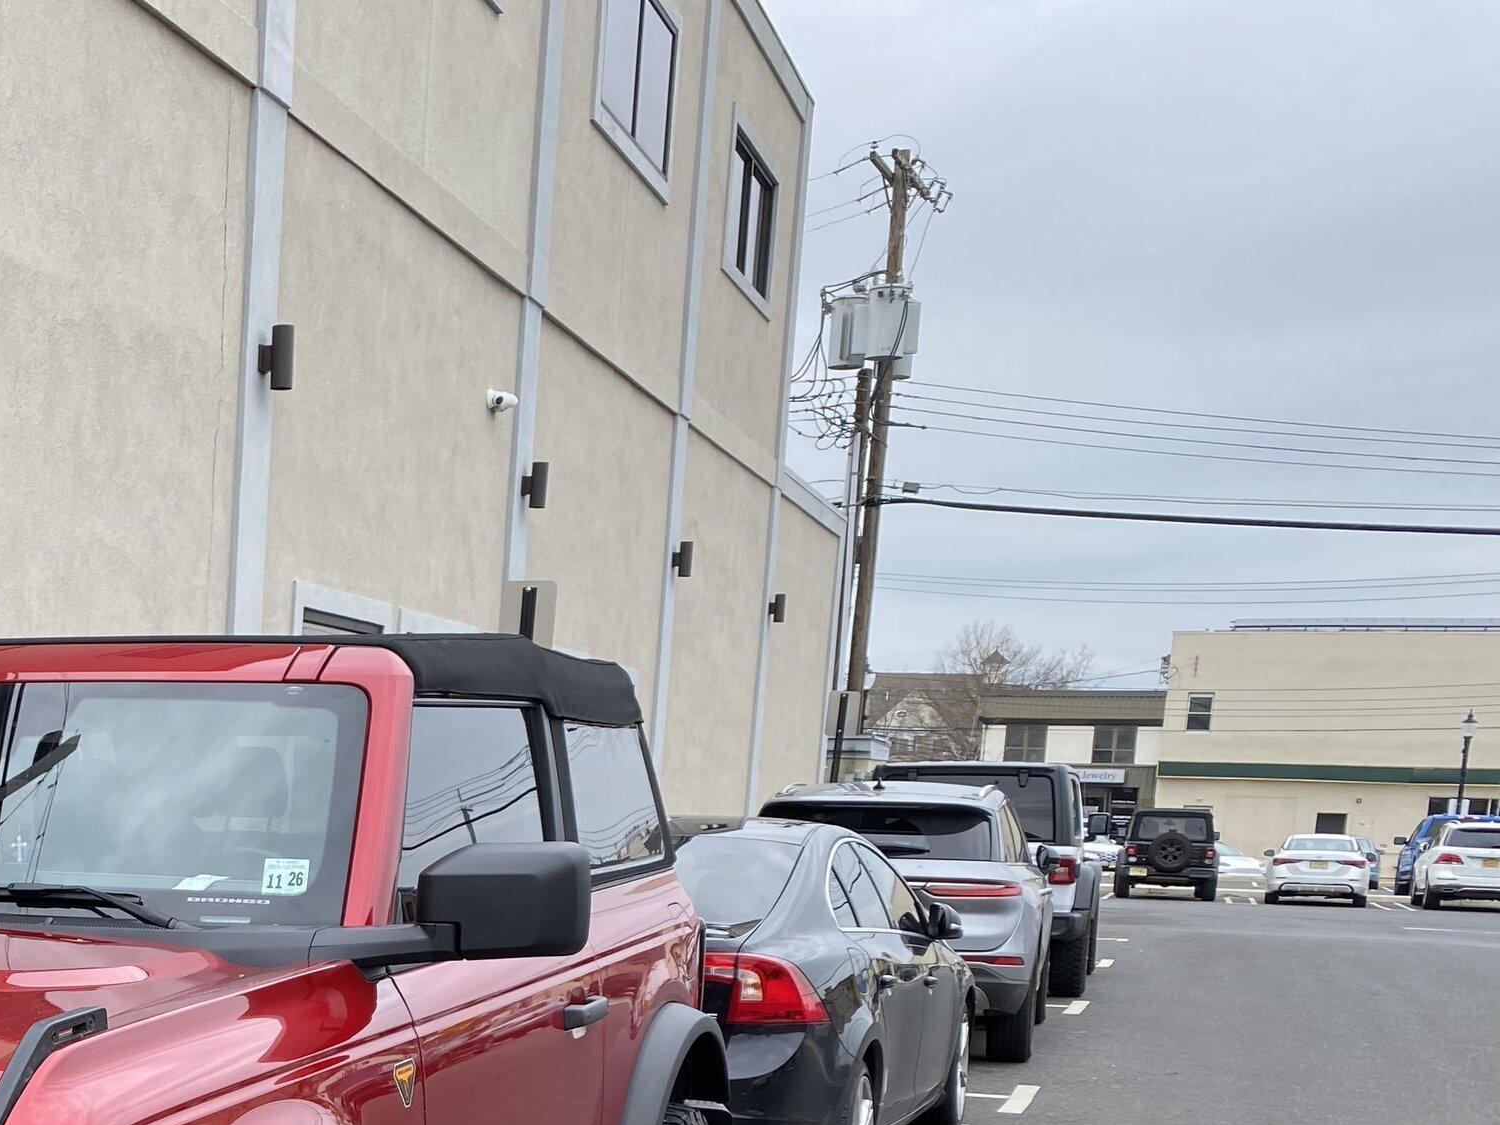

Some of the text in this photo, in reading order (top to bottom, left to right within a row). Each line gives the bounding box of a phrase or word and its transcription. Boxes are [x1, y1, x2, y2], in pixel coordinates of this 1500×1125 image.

[1082, 771, 1117, 780] Jewelry
[267, 871, 304, 889] 11 26
